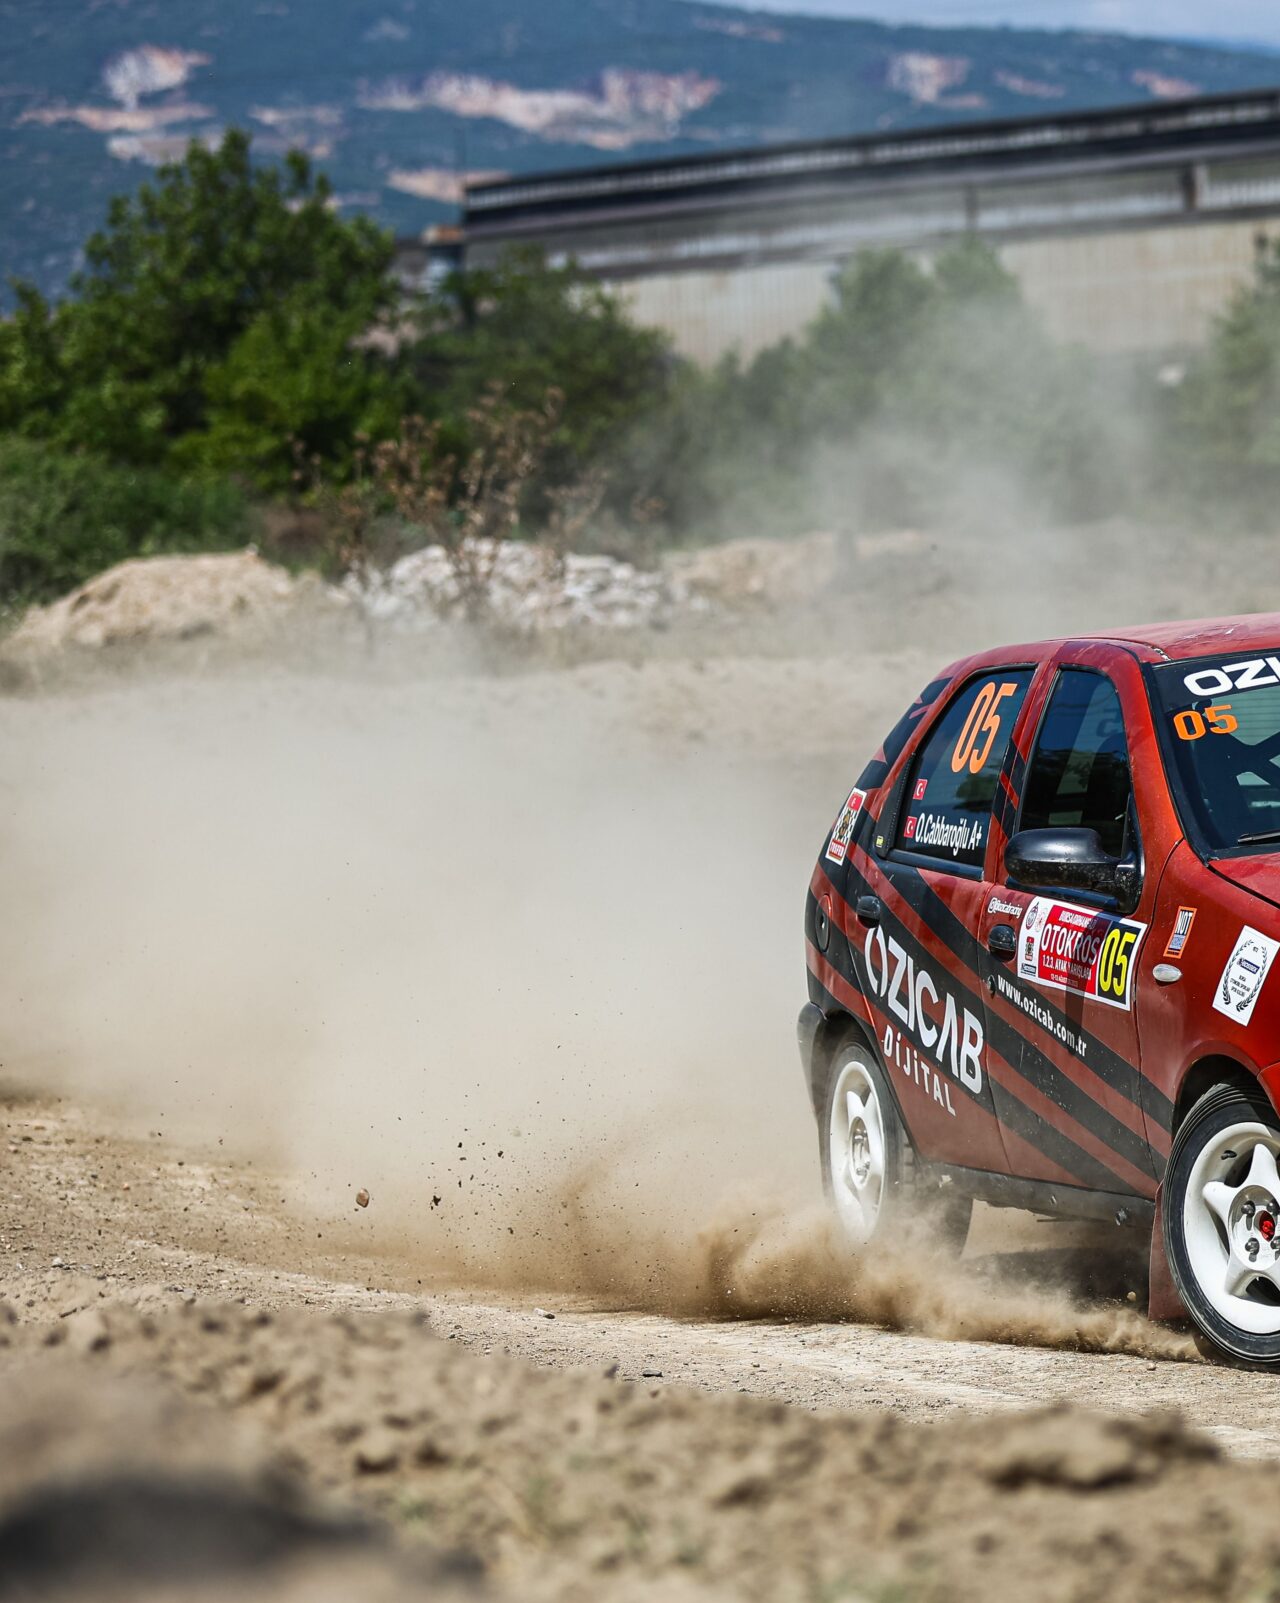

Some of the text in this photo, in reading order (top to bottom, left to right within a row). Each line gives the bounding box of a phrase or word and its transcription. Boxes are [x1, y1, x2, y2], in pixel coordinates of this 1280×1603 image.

[951, 682, 1018, 774] 05
[1173, 705, 1238, 741] 05
[1041, 923, 1100, 966] OTOKROS
[1100, 928, 1137, 997] 05
[864, 925, 984, 1094] OZICAB
[997, 974, 1088, 1057] www.ozicab.com.tr
